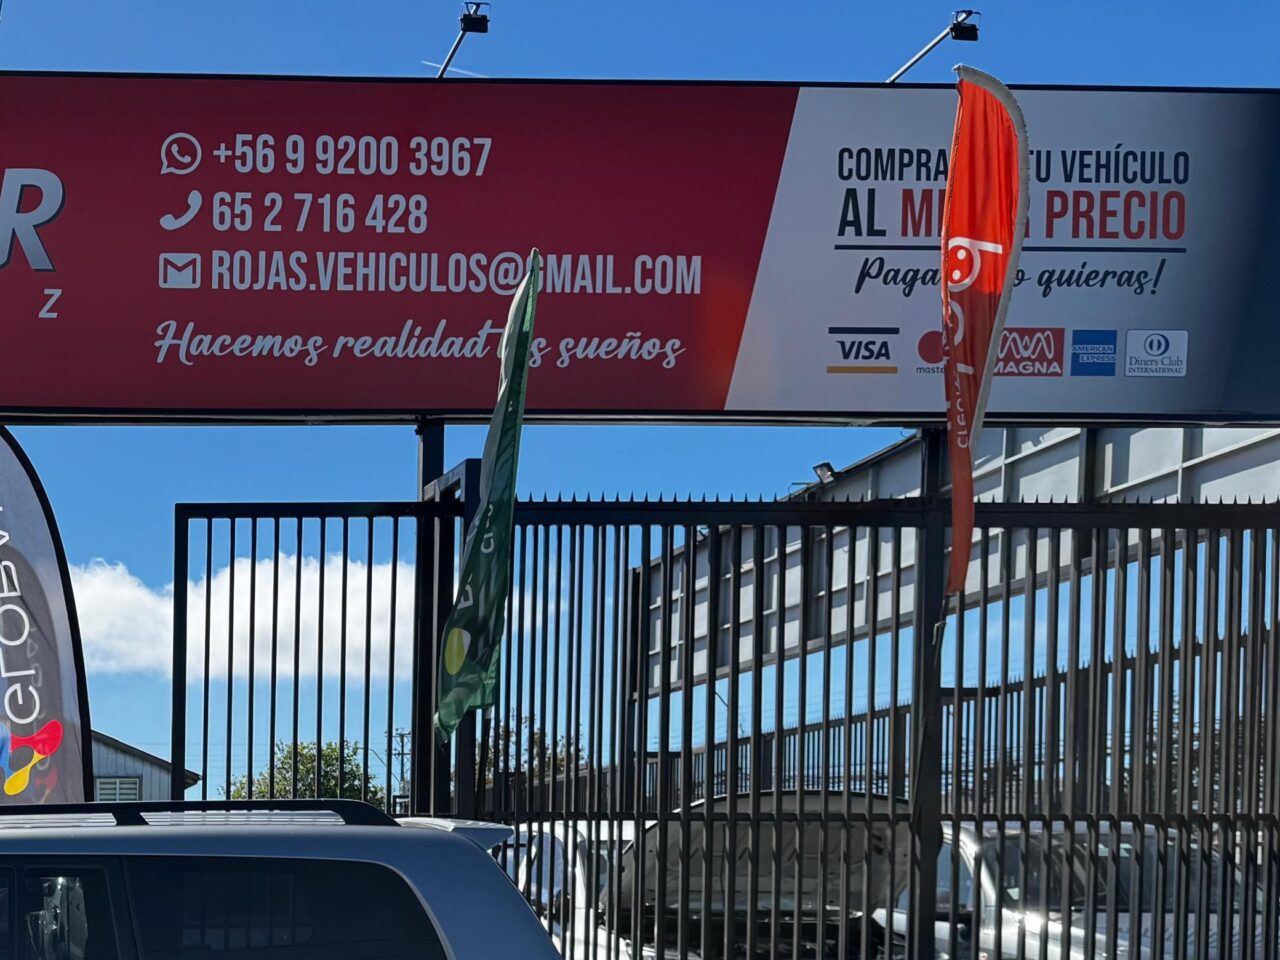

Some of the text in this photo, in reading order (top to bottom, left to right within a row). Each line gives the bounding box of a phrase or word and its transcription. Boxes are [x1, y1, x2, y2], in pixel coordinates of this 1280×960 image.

[213, 133, 492, 177] +56 9 9200 3967
[837, 143, 1190, 185] COMPRA U VEHÍCULO
[212, 191, 428, 234] 65 2 716 428
[837, 187, 887, 237] AL
[1045, 190, 1186, 241] PRECIO
[1037, 258, 1167, 299] quieras!
[153, 319, 329, 367] Hacemos
[332, 318, 492, 359] realidad
[556, 331, 686, 369] sueños
[836, 340, 891, 361] VISA
[1072, 344, 1115, 353] AMERICAN
[1079, 354, 1117, 363] EXPRESS
[1129, 356, 1183, 366] Diners Club
[1128, 366, 1183, 374] INTERNATIONAL
